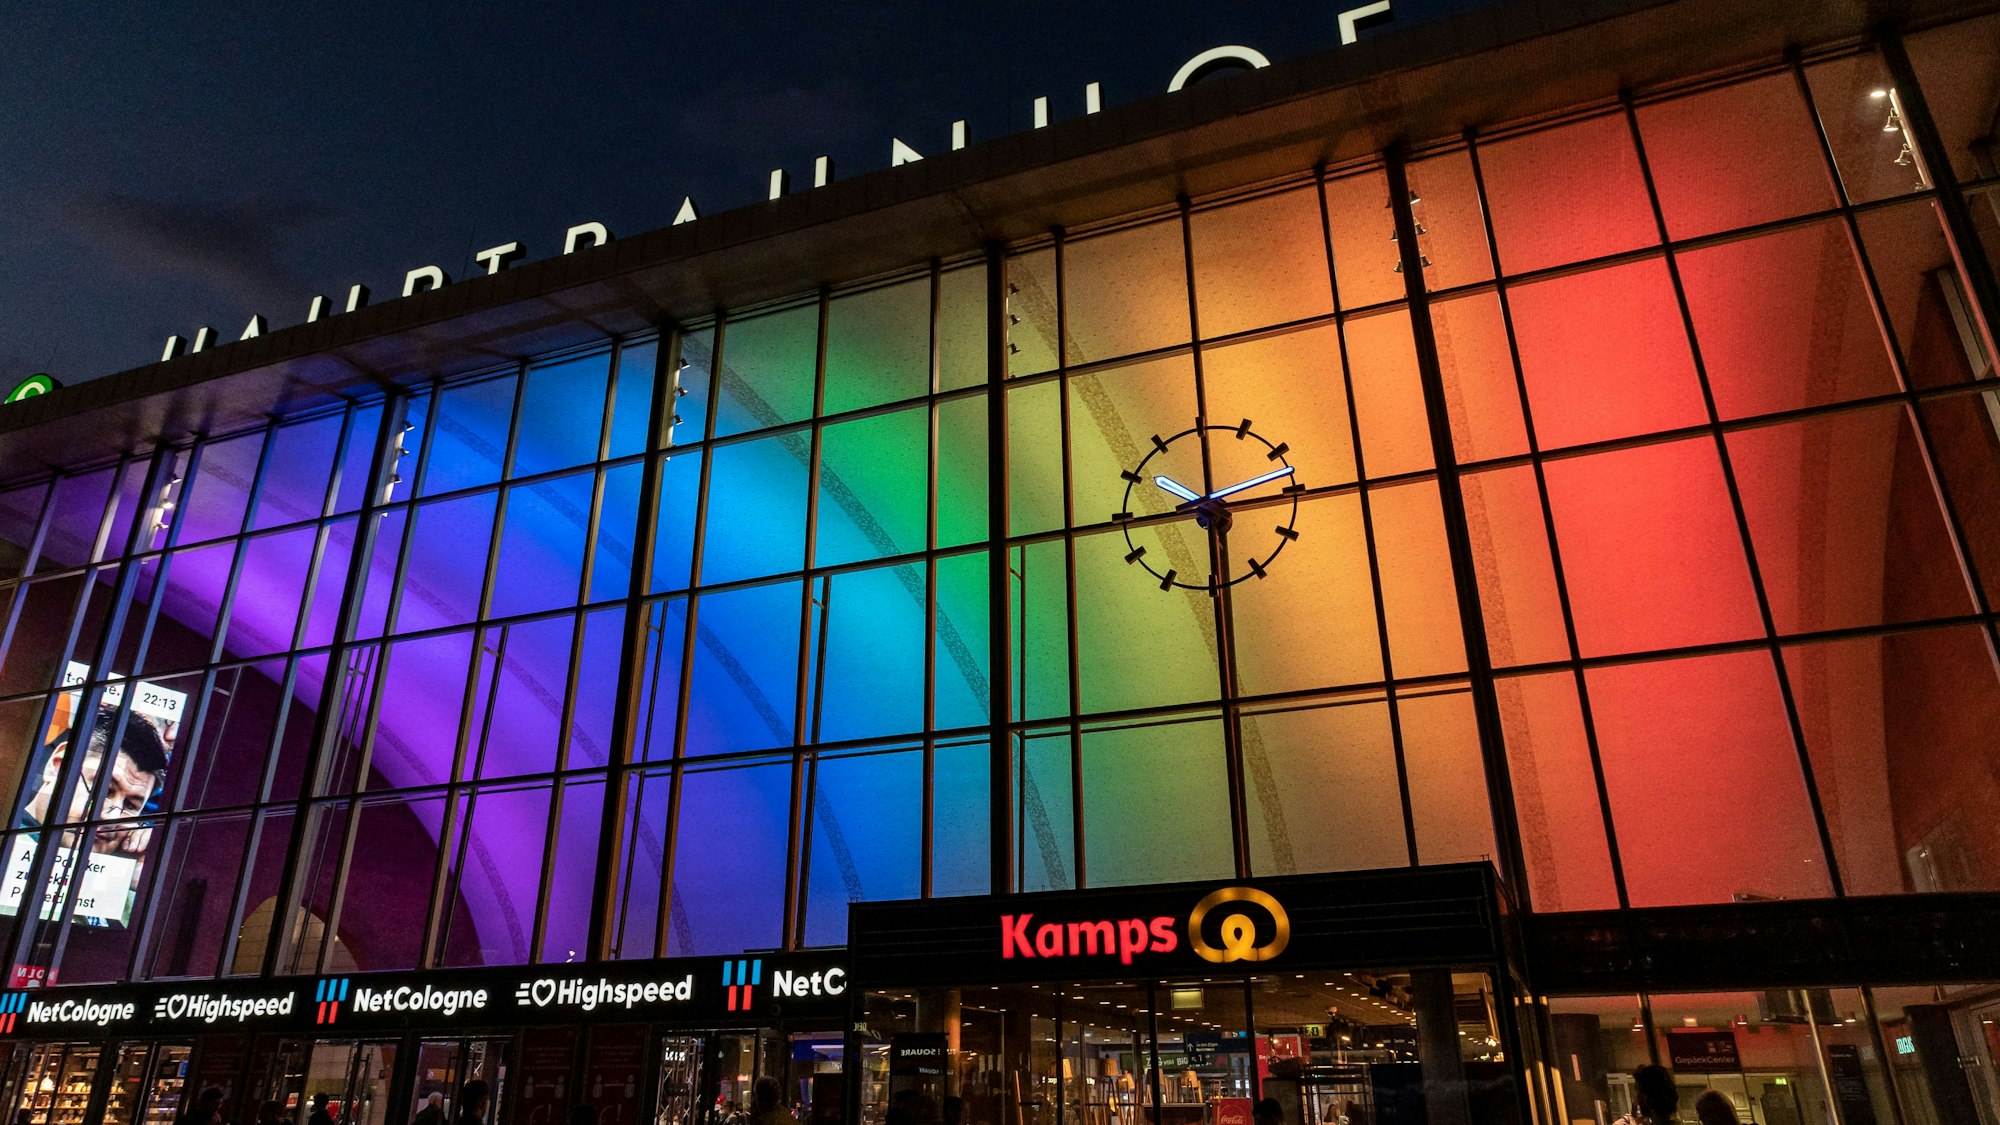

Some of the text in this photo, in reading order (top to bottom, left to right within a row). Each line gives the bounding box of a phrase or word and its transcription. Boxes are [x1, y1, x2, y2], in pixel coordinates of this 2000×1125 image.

[143, 693, 177, 710] 22:13
[1002, 914, 1177, 964] Kamps
[557, 975, 692, 1010] Highspeed
[774, 968, 846, 996] NetC
[27, 999, 134, 1026] NetCologne
[187, 992, 294, 1023] Highspeed
[354, 986, 487, 1015] NetCologne
[1675, 1056, 1735, 1065] GepäckCenter
